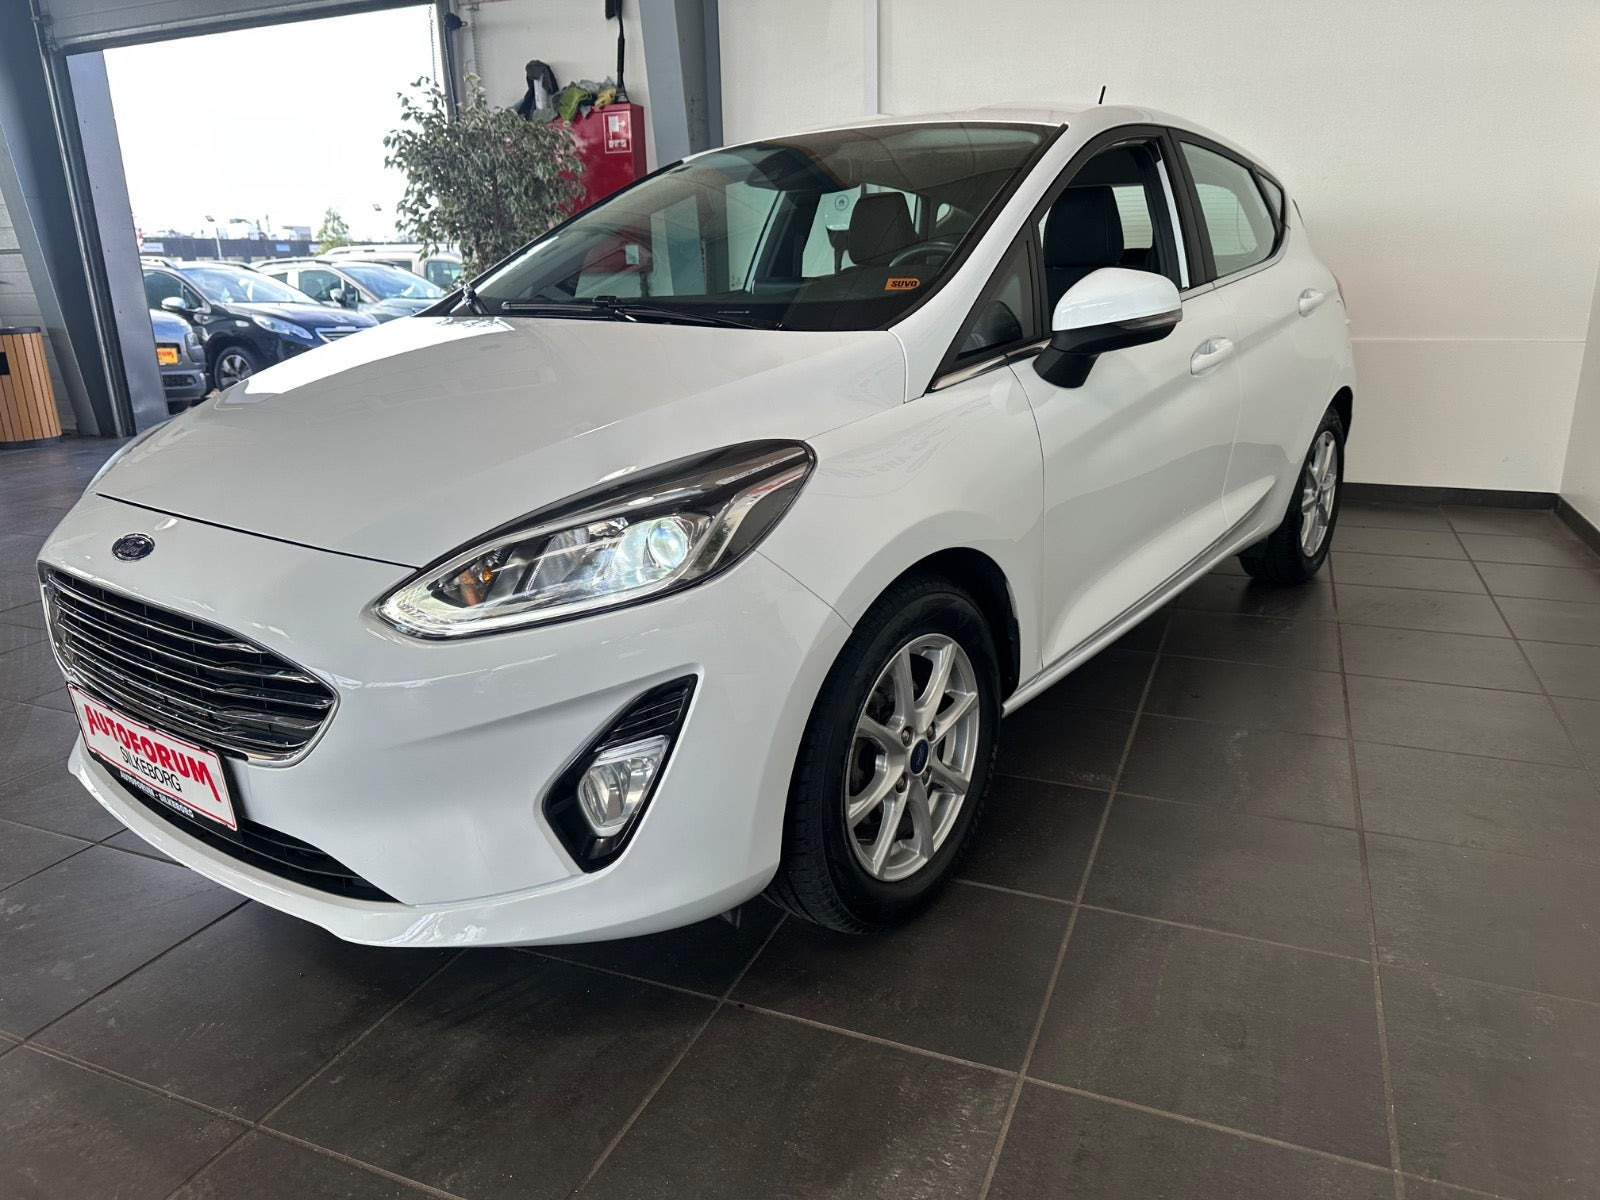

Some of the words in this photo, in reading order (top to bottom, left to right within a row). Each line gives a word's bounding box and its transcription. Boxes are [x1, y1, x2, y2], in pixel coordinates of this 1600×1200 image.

[891, 280, 918, 288] SUVO
[84, 704, 221, 803] AUTOFORUM
[119, 746, 182, 792] SILKEBORG
